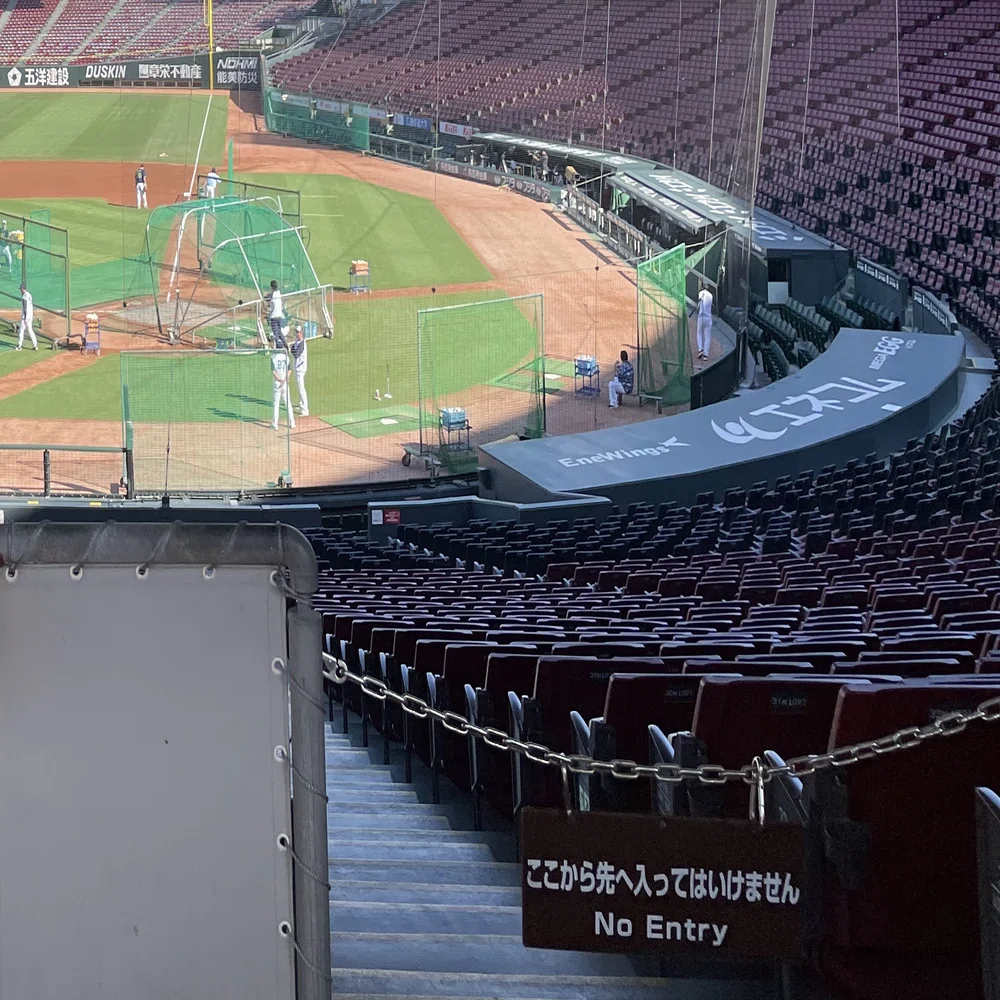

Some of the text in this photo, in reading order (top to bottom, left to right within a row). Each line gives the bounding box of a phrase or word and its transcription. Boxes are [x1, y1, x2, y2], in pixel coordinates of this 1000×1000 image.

[24, 67, 69, 86] 五洋建設
[85, 64, 127, 79] DUSKIN
[217, 71, 258, 84] 能美防災
[558, 443, 671, 469] EneWings
[526, 859, 800, 906] ここから先へ入ってはいけません
[594, 911, 728, 947] No Entry
